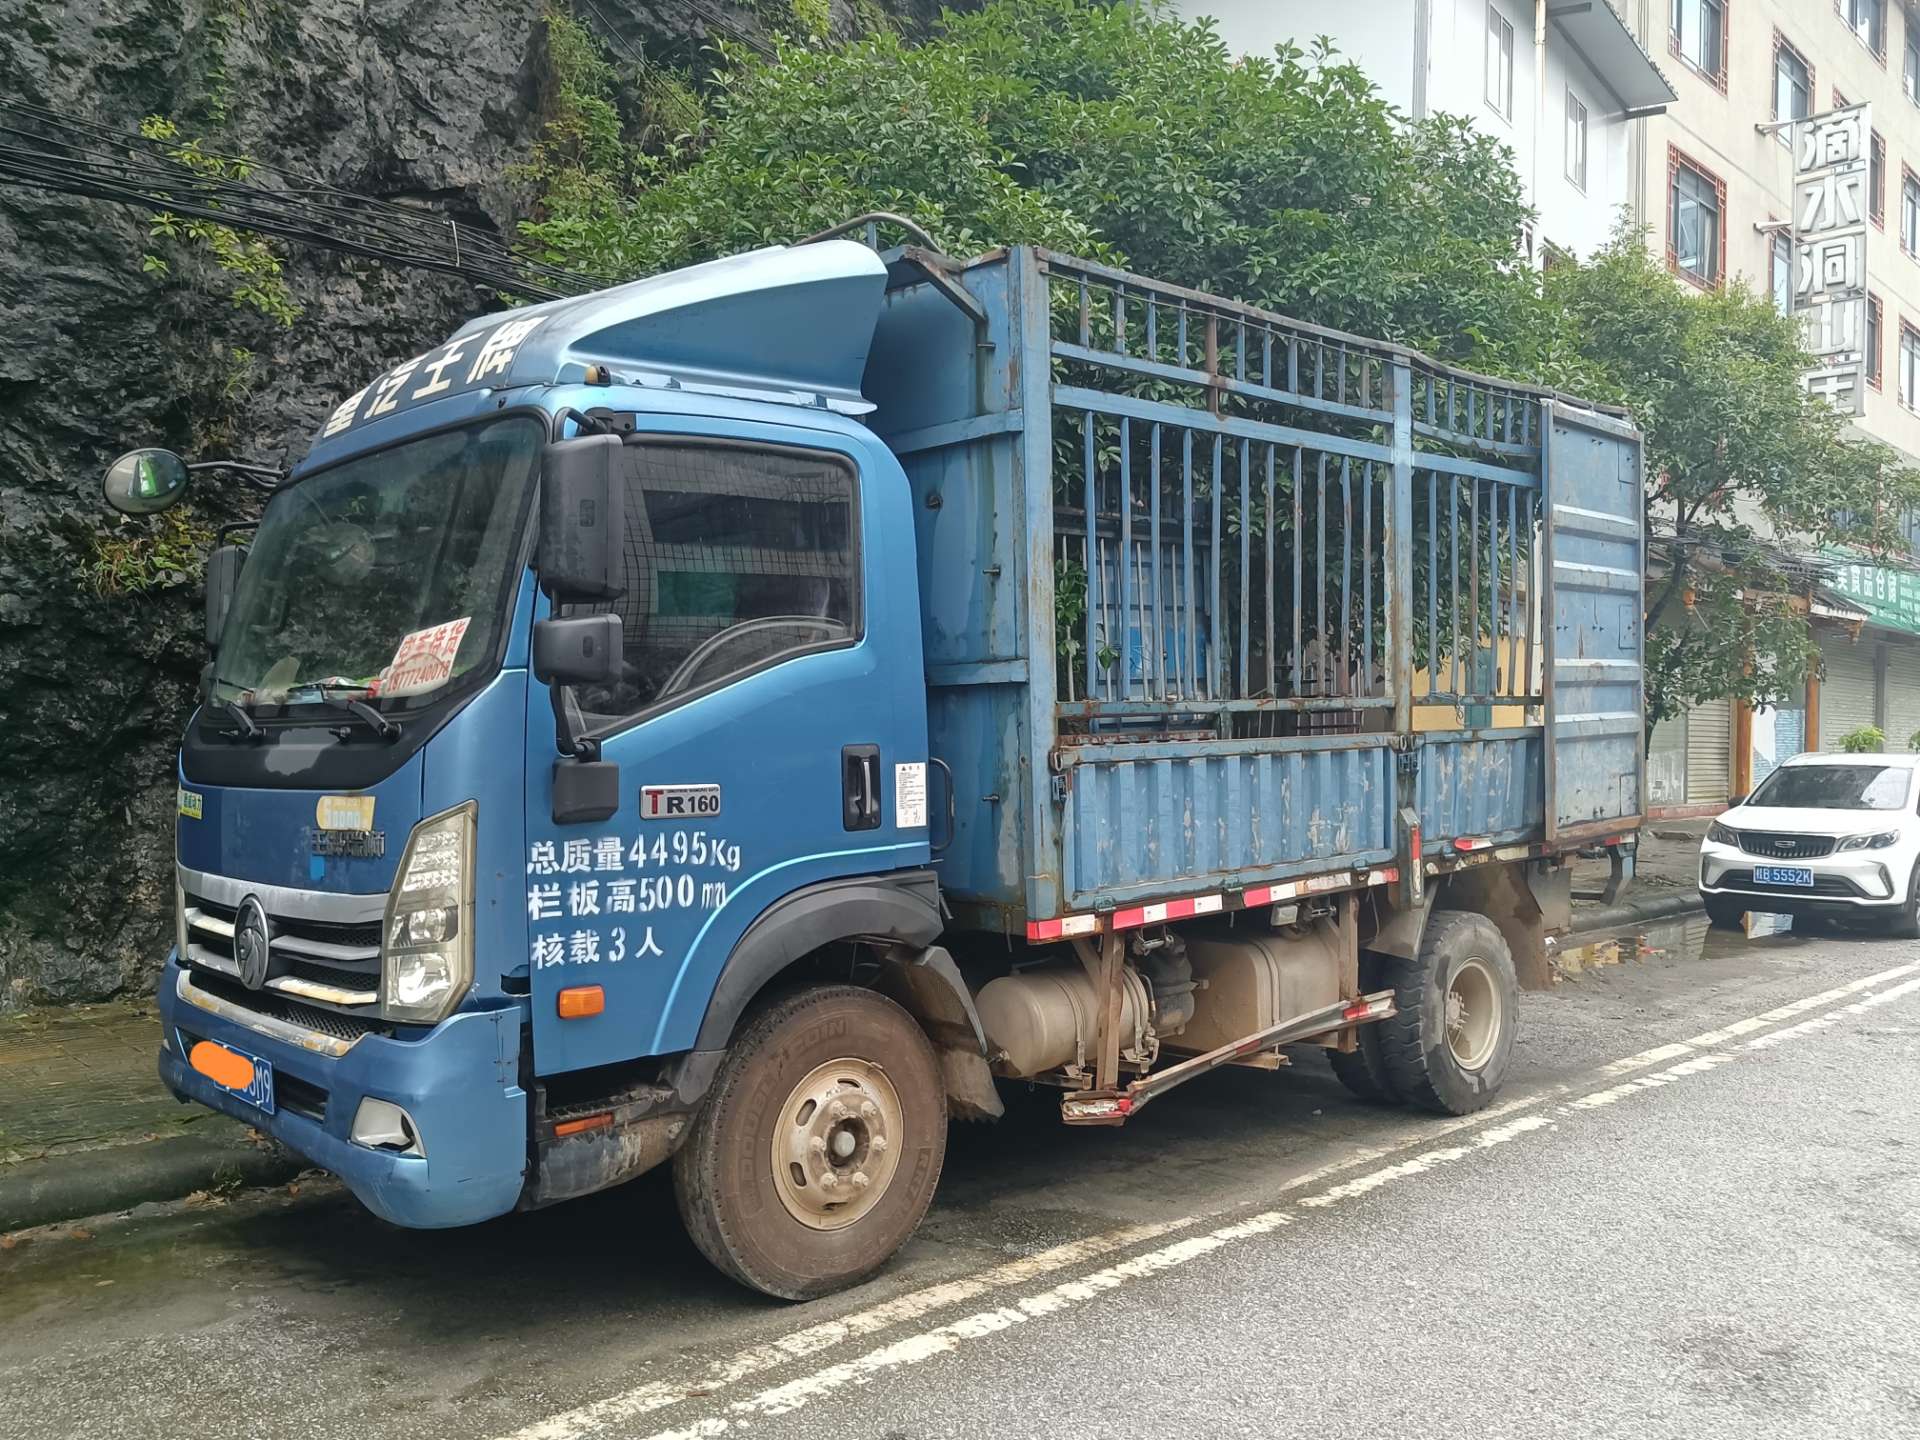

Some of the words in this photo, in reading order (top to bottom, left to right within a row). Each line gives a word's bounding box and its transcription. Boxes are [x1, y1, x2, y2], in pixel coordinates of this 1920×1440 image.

[527, 830, 741, 875] 总质量4495Kg
[531, 926, 664, 970] 核载3人
